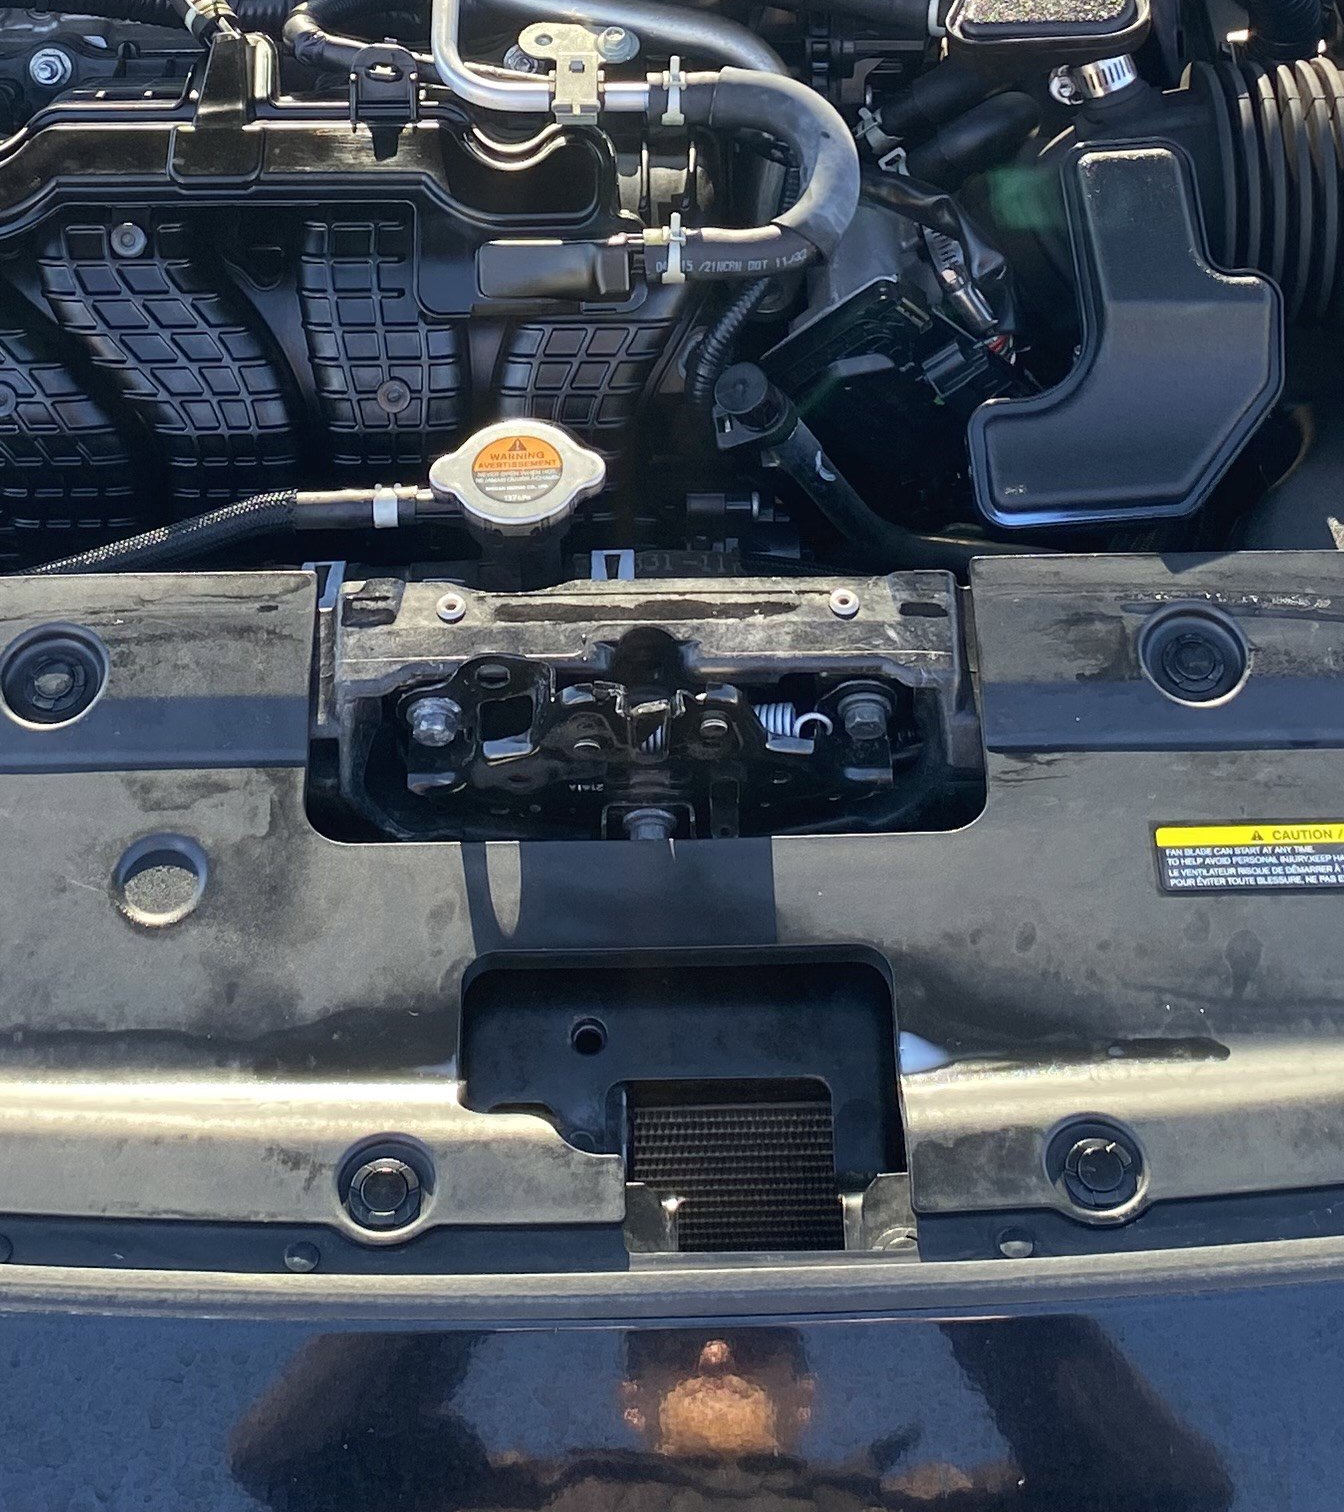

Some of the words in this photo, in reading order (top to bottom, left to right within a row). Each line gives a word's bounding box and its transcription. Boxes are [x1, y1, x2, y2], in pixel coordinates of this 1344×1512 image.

[748, 260, 767, 271] DOT
[490, 451, 544, 460] WARNING
[479, 460, 557, 468] AVERTISSEMENT
[1272, 829, 1333, 841] CAUTION
[1338, 829, 1343, 839] /
[1166, 848, 1183, 856] FAN
[1184, 847, 1212, 856] BLADE
[1214, 847, 1233, 855] CAN
[1234, 846, 1260, 855] START
[1262, 846, 1273, 854] AT
[1274, 846, 1293, 854] ANY
[1293, 845, 1315, 853] TIME.
[1167, 858, 1179, 866] TO
[1181, 857, 1203, 866] HELP
[1204, 857, 1231, 865] AVOID
[1232, 856, 1278, 865] PERSONAL
[1169, 869, 1179, 877] LE
[1181, 868, 1236, 877] VENTILATEUR
[1238, 867, 1270, 876] RISQUE
[1272, 866, 1284, 875] DE
[1285, 864, 1333, 874] DÉMARRER
[1334, 863, 1341, 873] À
[1170, 878, 1195, 887] POUR
[1196, 876, 1226, 886] ÉVITER
[1227, 877, 1255, 885] TOUTE
[1305, 875, 1317, 884] NE
[1319, 875, 1336, 883] PAS
